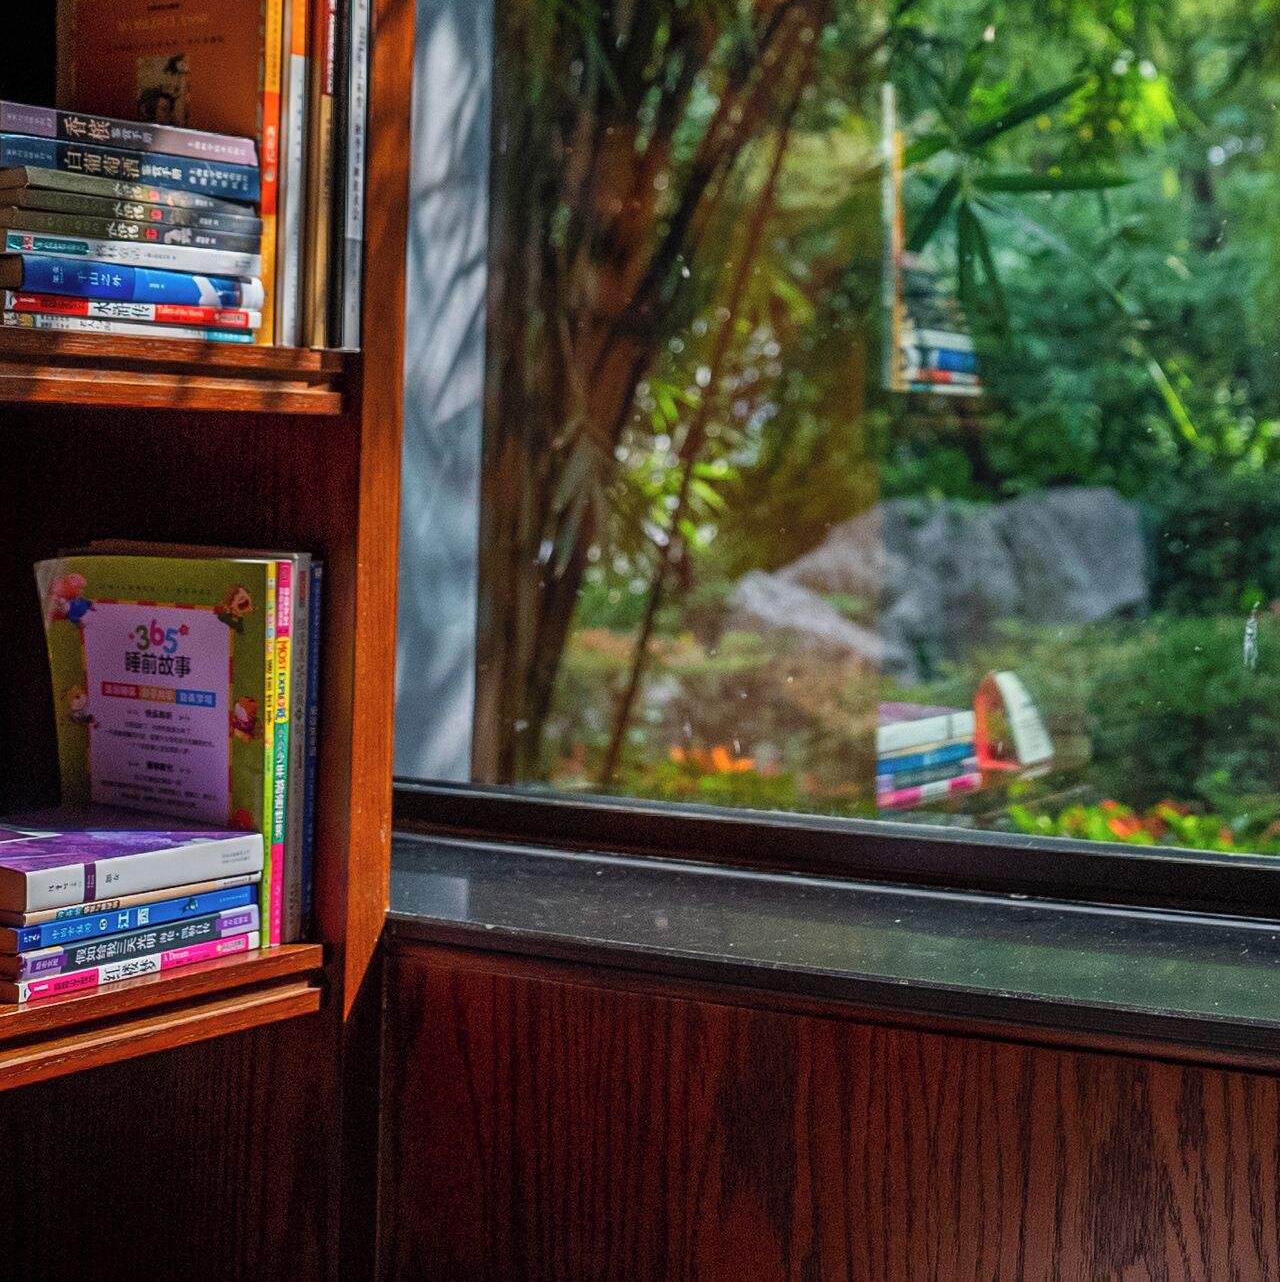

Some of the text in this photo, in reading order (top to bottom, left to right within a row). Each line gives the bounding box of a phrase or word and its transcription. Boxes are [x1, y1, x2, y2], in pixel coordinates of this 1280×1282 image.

[92, 300, 149, 317] 水浒传
[134, 619, 179, 655] 365
[124, 651, 192, 679] 睡前故事
[117, 907, 149, 929] 江西
[74, 931, 157, 965] 假如给我三天光明
[103, 957, 156, 982] 红楼梦
